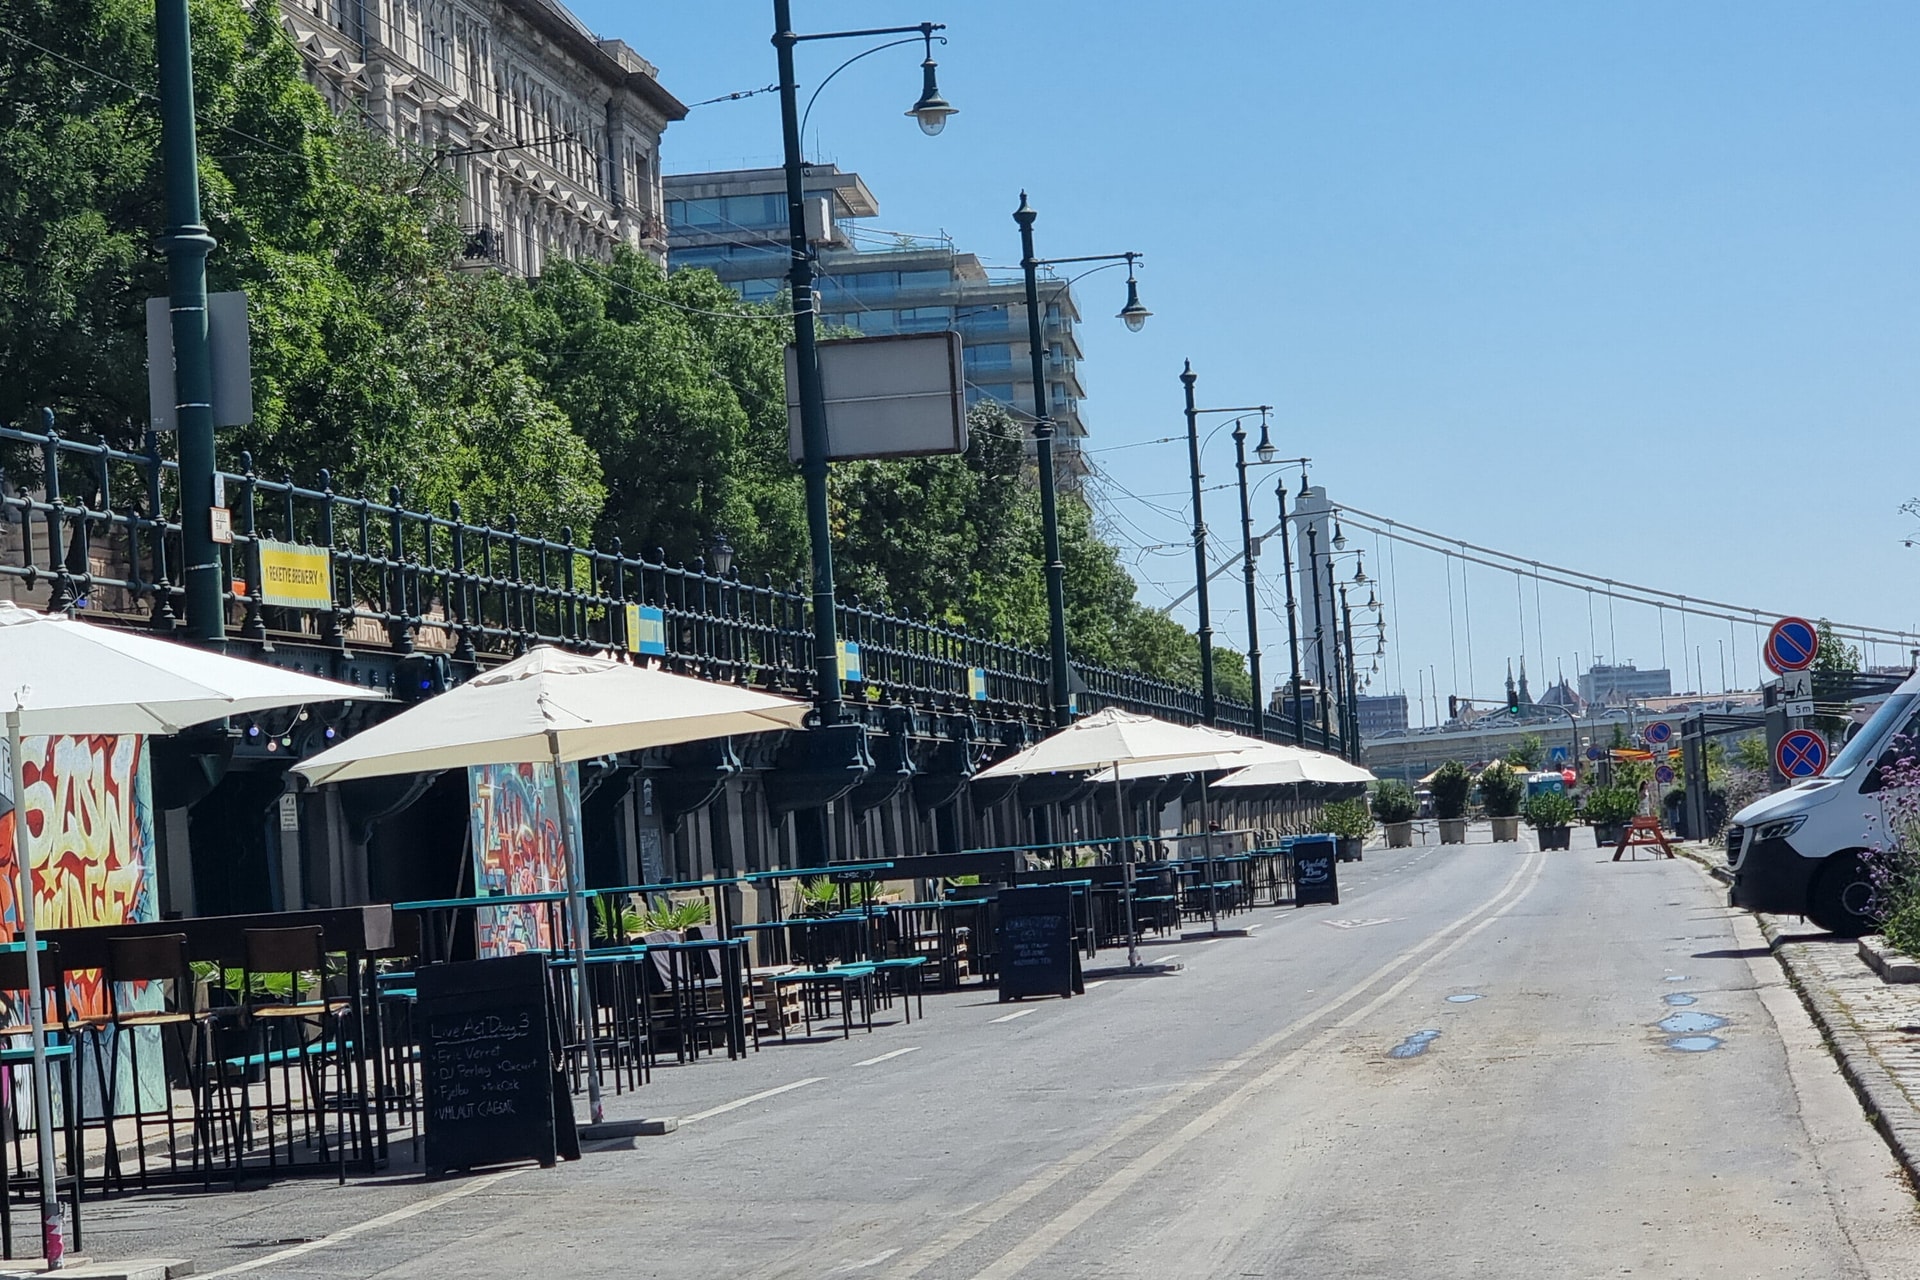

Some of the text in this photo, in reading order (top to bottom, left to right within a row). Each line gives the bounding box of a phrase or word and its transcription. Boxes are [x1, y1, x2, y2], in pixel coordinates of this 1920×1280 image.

[292, 568, 318, 585] BREWERY
[1795, 705, 1801, 713] 5
[431, 1012, 530, 1040] Live Act Day 3
[440, 1068, 454, 1080] DJ
